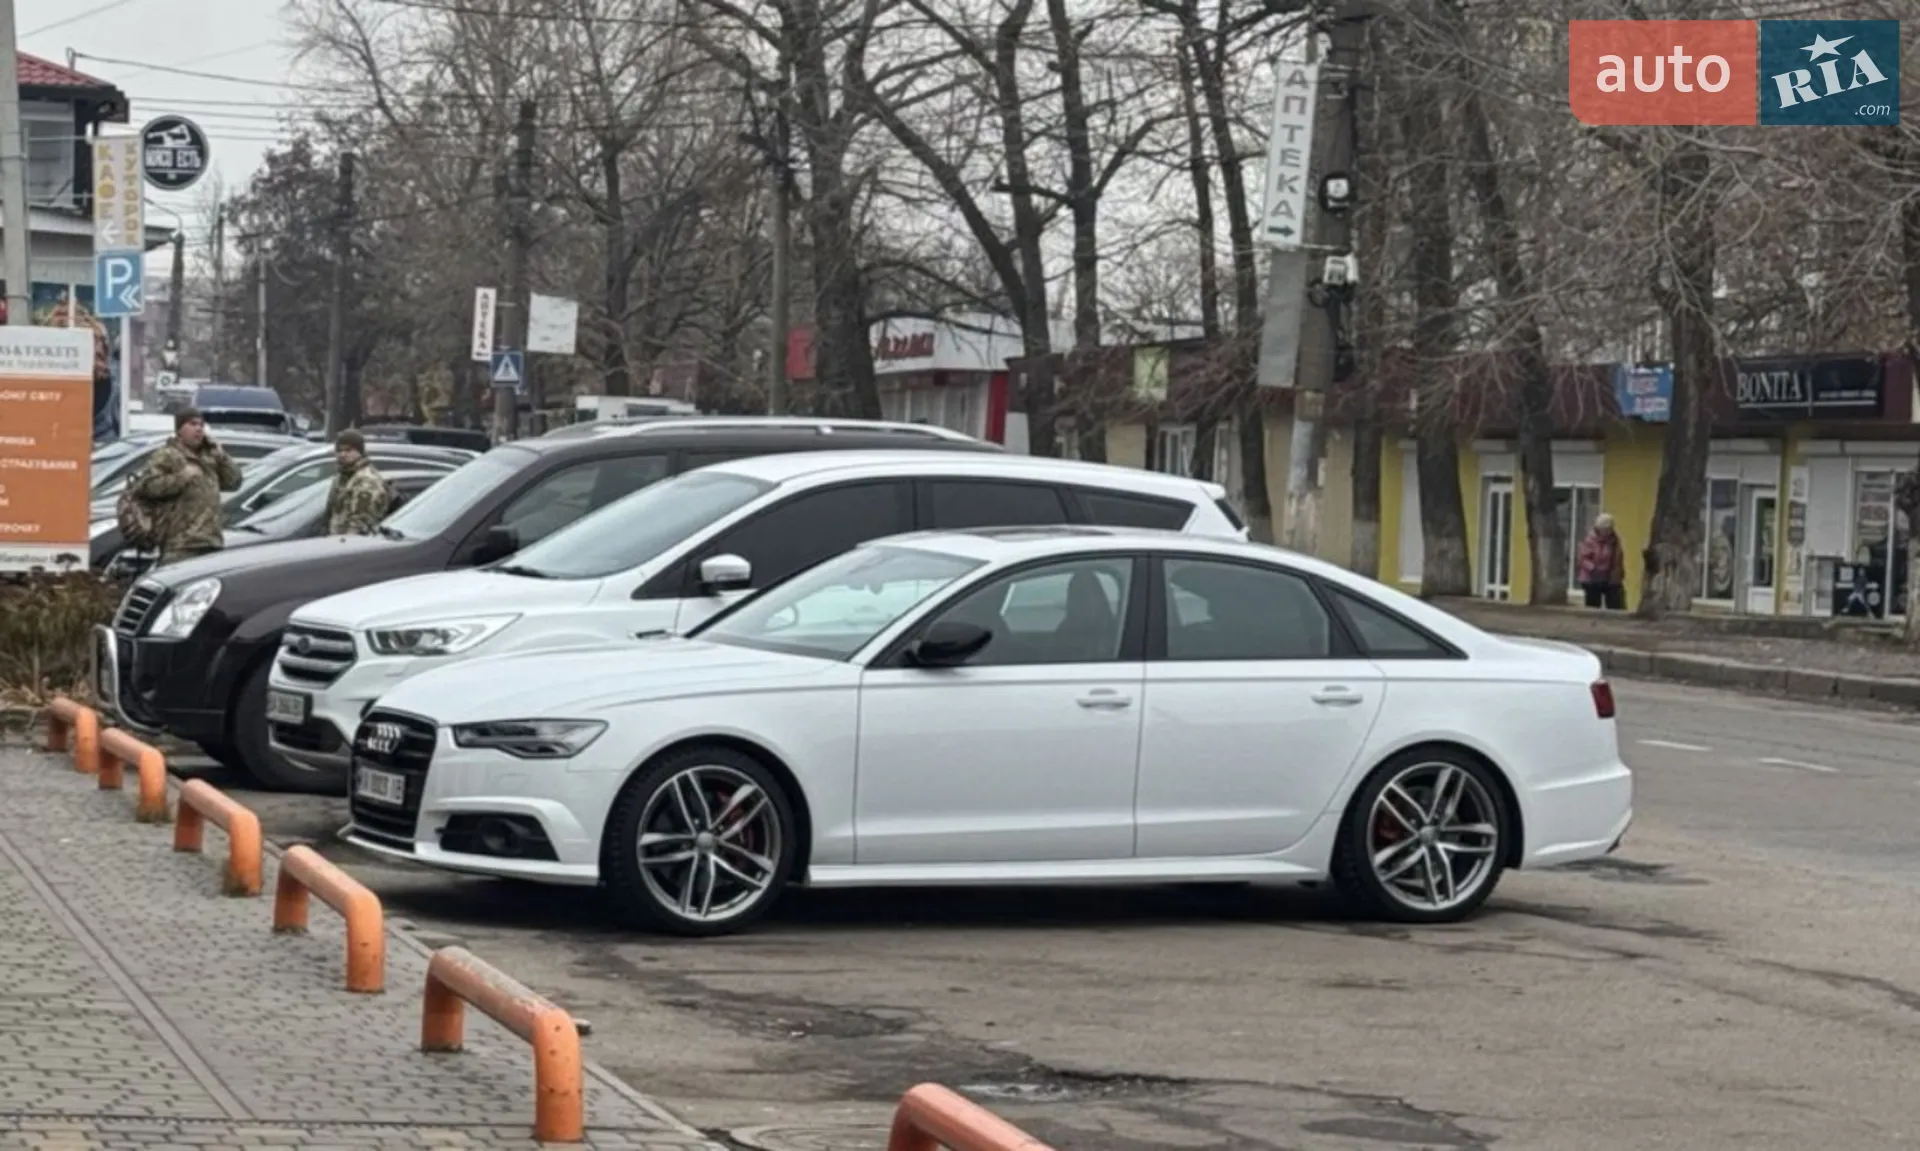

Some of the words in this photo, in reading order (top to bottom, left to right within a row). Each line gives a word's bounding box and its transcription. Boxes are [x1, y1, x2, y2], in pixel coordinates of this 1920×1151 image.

[1271, 69, 1309, 220] АПТЕКА
[97, 144, 116, 219] КАФЕ
[105, 258, 132, 300] P
[1736, 371, 1802, 402] BONITA
